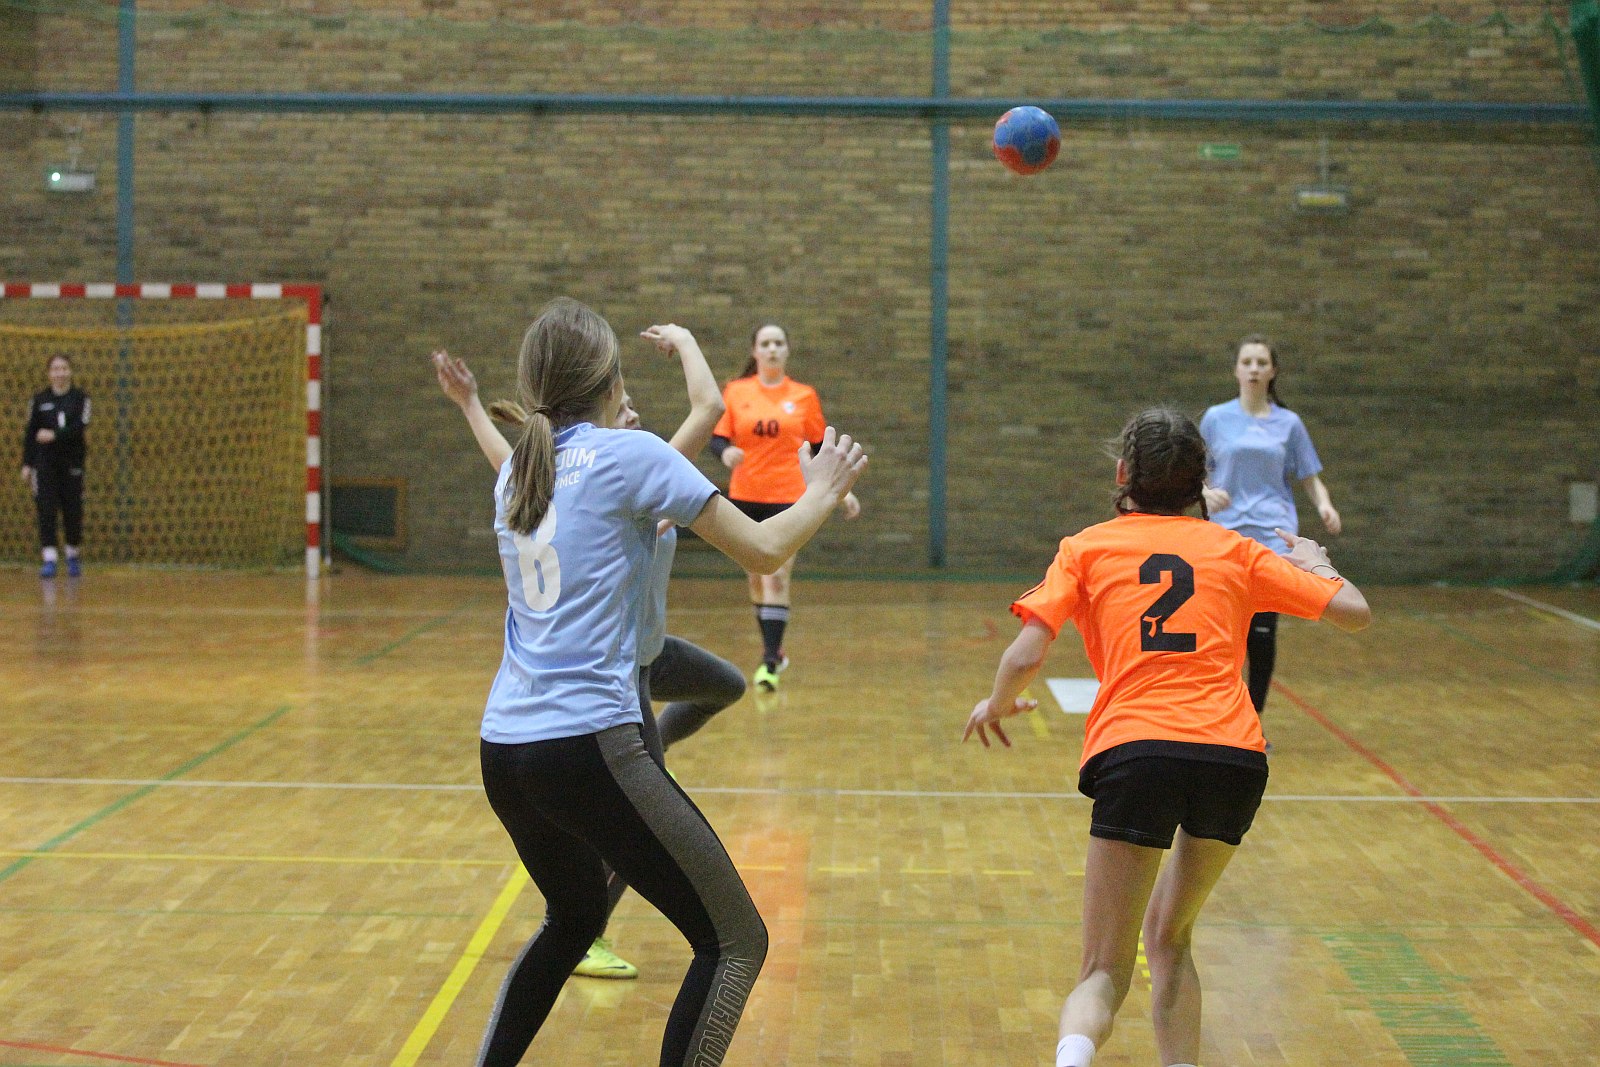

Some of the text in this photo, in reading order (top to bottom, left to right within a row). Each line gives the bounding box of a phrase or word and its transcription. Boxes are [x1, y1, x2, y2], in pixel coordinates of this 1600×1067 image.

[753, 419, 779, 437] 40
[555, 447, 597, 471] JUM
[1139, 553, 1197, 653] 2
